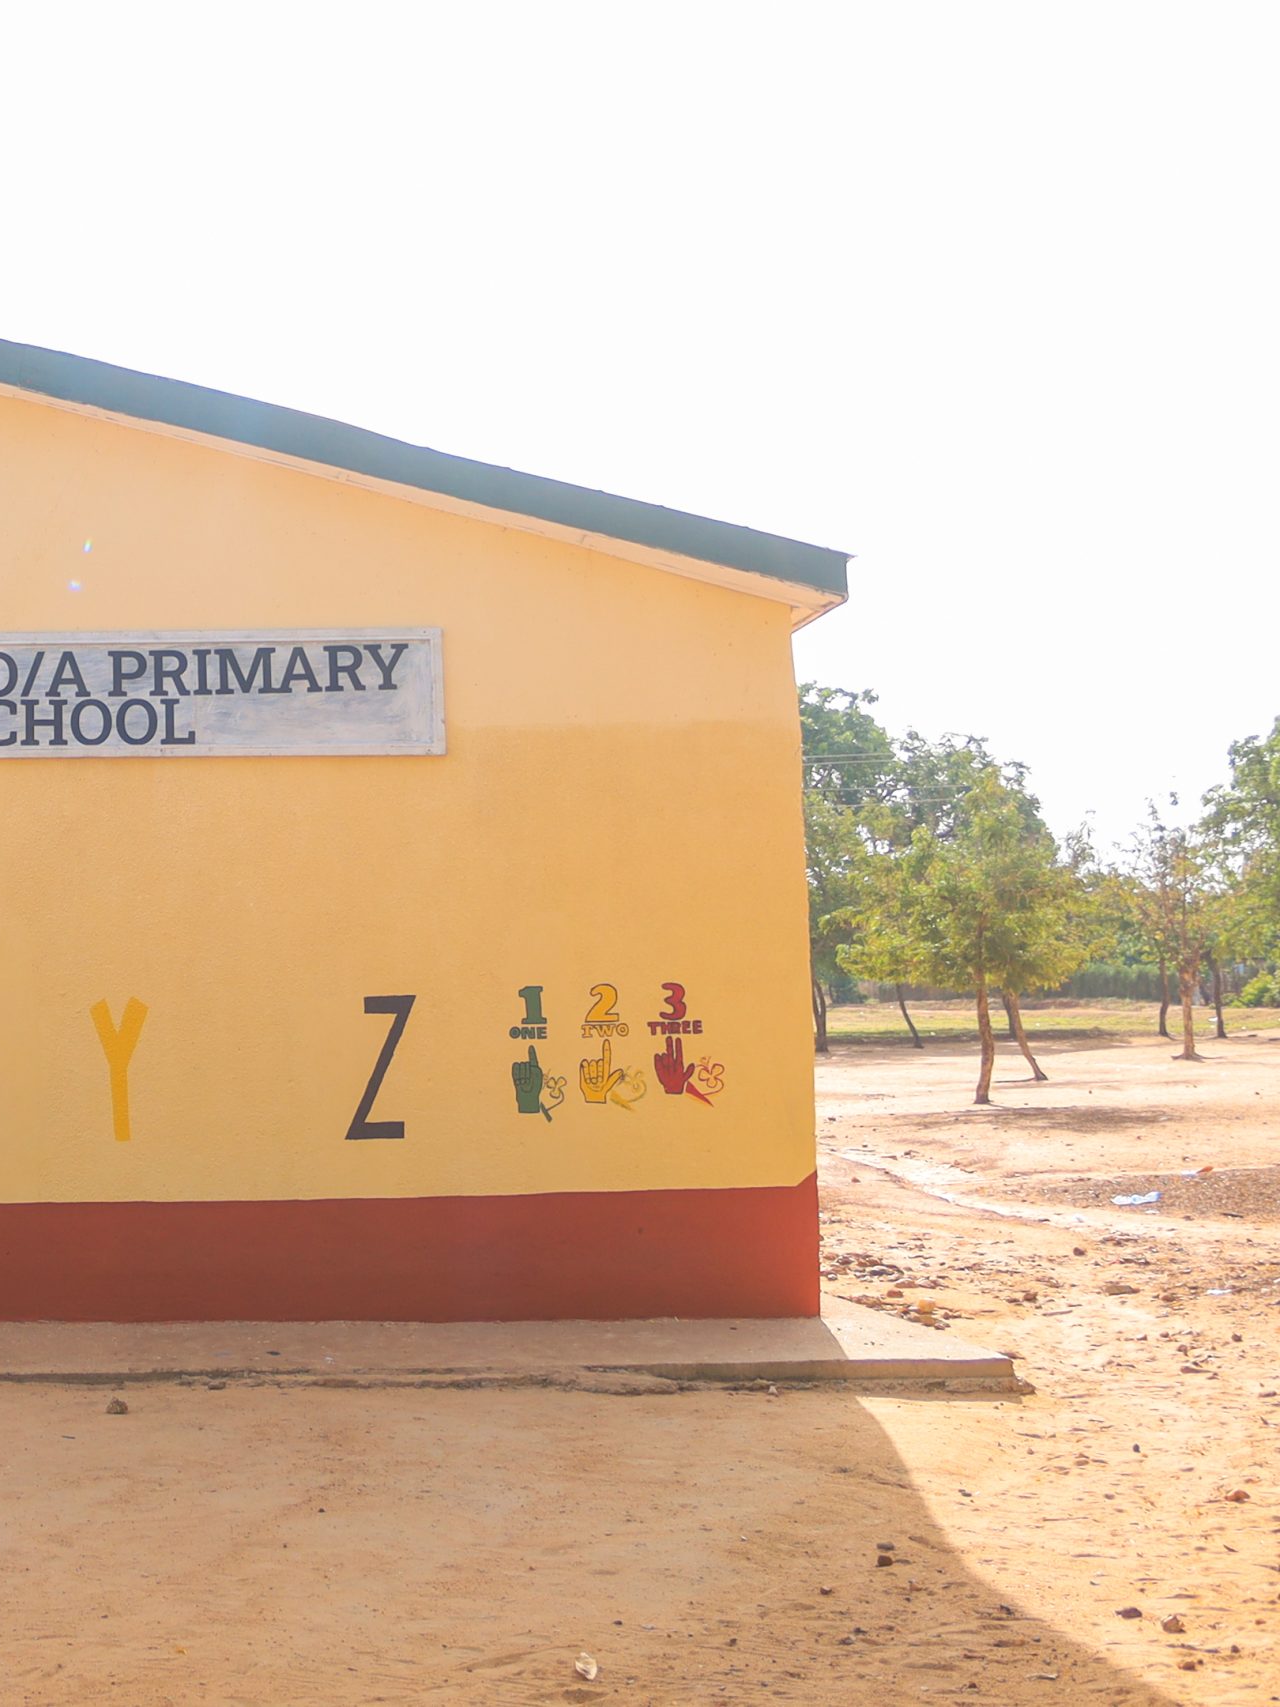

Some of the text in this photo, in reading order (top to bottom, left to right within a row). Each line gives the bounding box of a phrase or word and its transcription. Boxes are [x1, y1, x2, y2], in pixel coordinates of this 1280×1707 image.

[108, 644, 409, 697] PRIMARY
[518, 982, 687, 1025] 1 2 3
[509, 1020, 703, 1040] ONE TWO THREE
[89, 996, 149, 1141] Y
[344, 995, 417, 1140] Z
